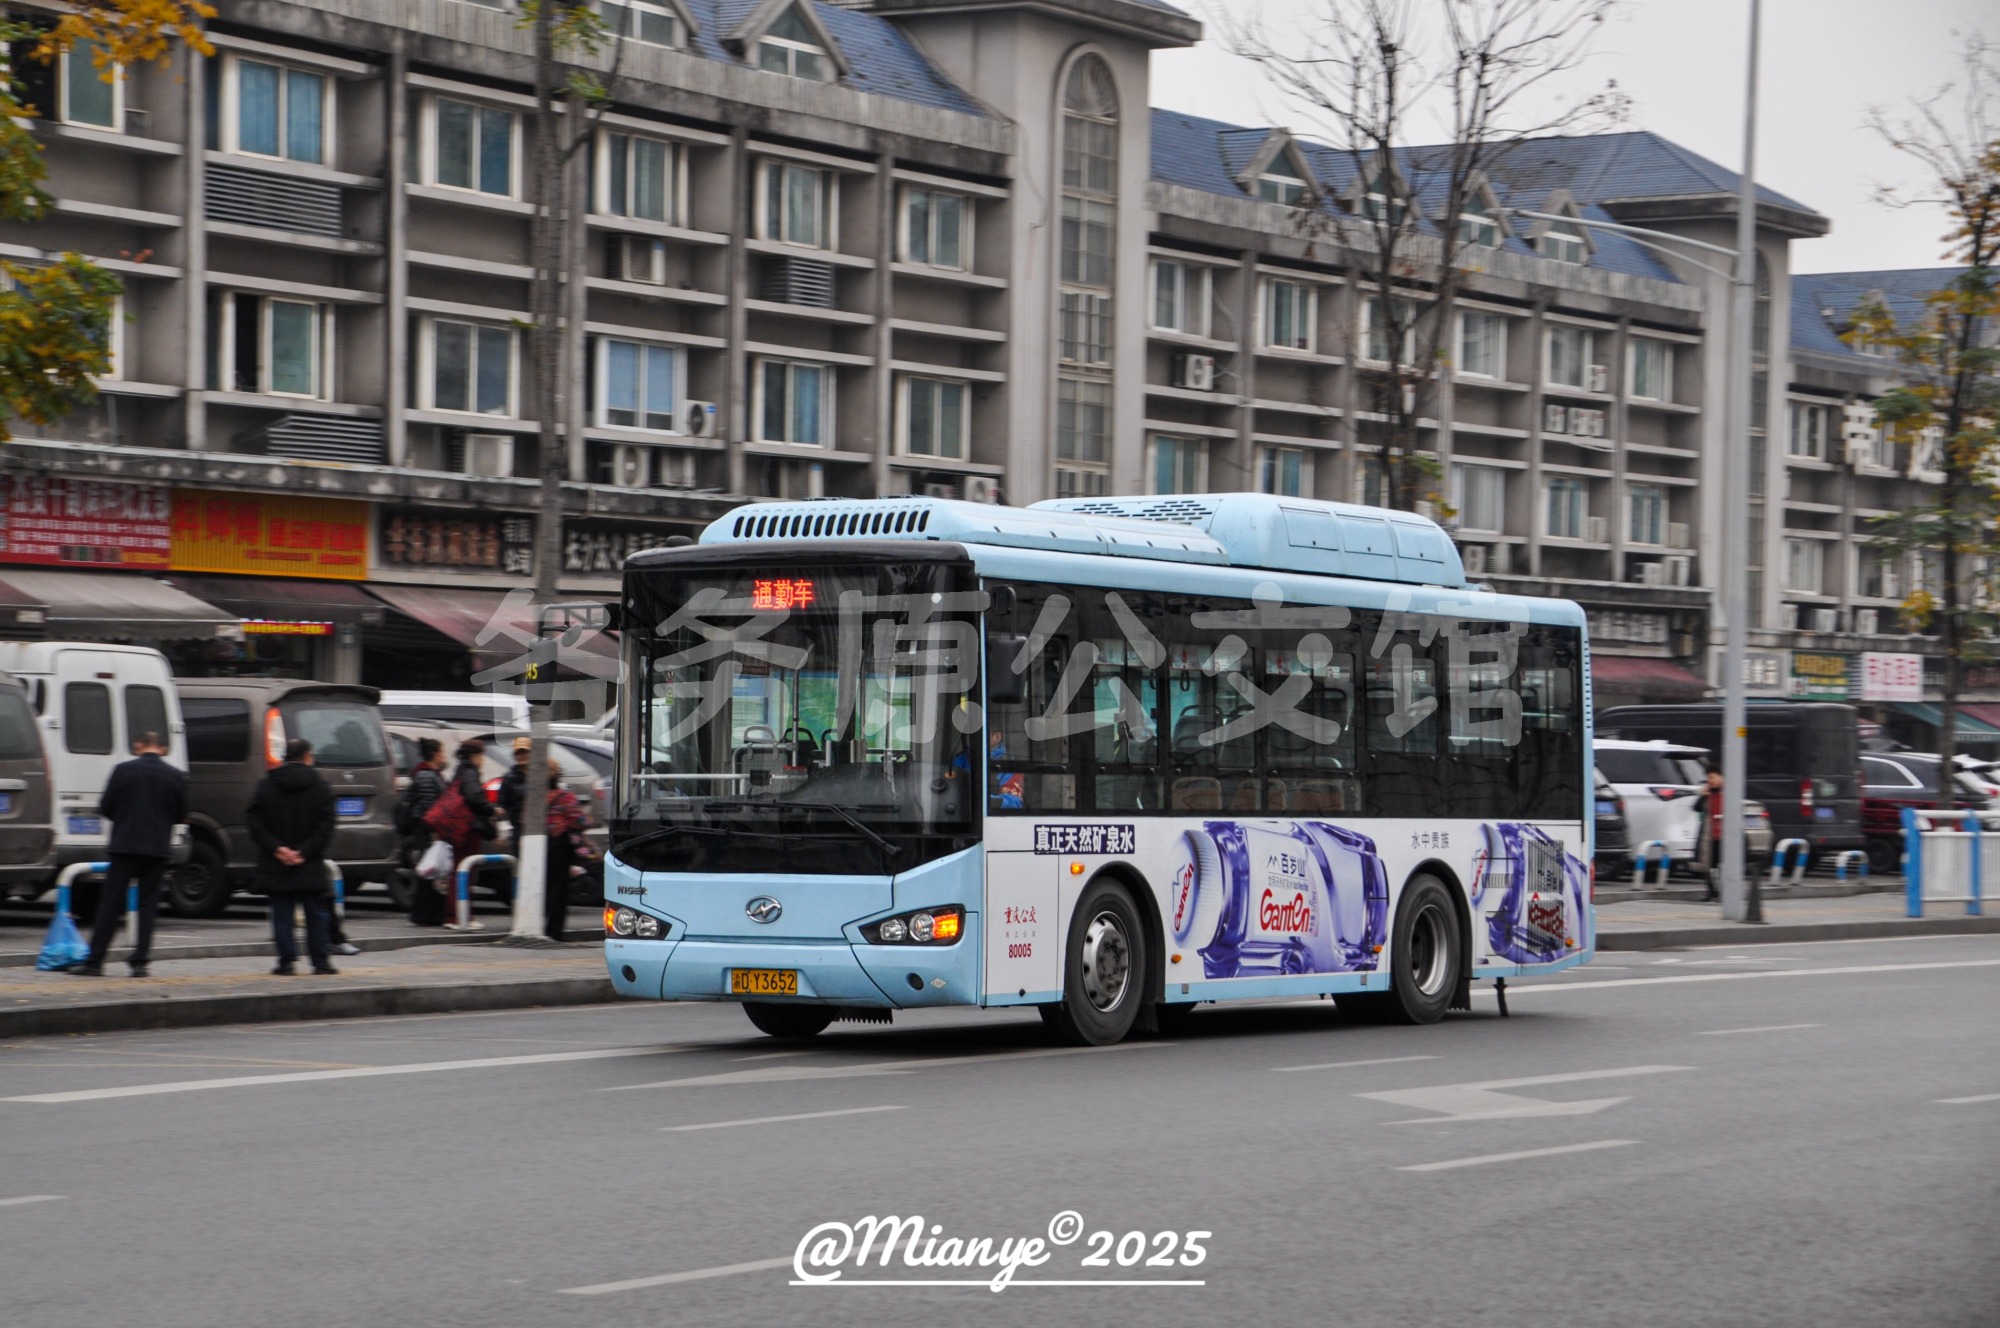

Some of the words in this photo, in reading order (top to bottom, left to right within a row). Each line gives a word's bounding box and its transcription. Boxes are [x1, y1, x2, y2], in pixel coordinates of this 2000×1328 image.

[752, 578, 814, 610] 通勤车
[1035, 825, 1135, 854] 真正天然矿泉水
[1411, 830, 1450, 850] 水中贵族
[1281, 852, 1306, 878] 百岁山
[1003, 905, 1038, 924] 重庆公交
[1260, 888, 1311, 932] Ganten
[1008, 943, 1032, 958] 80005
